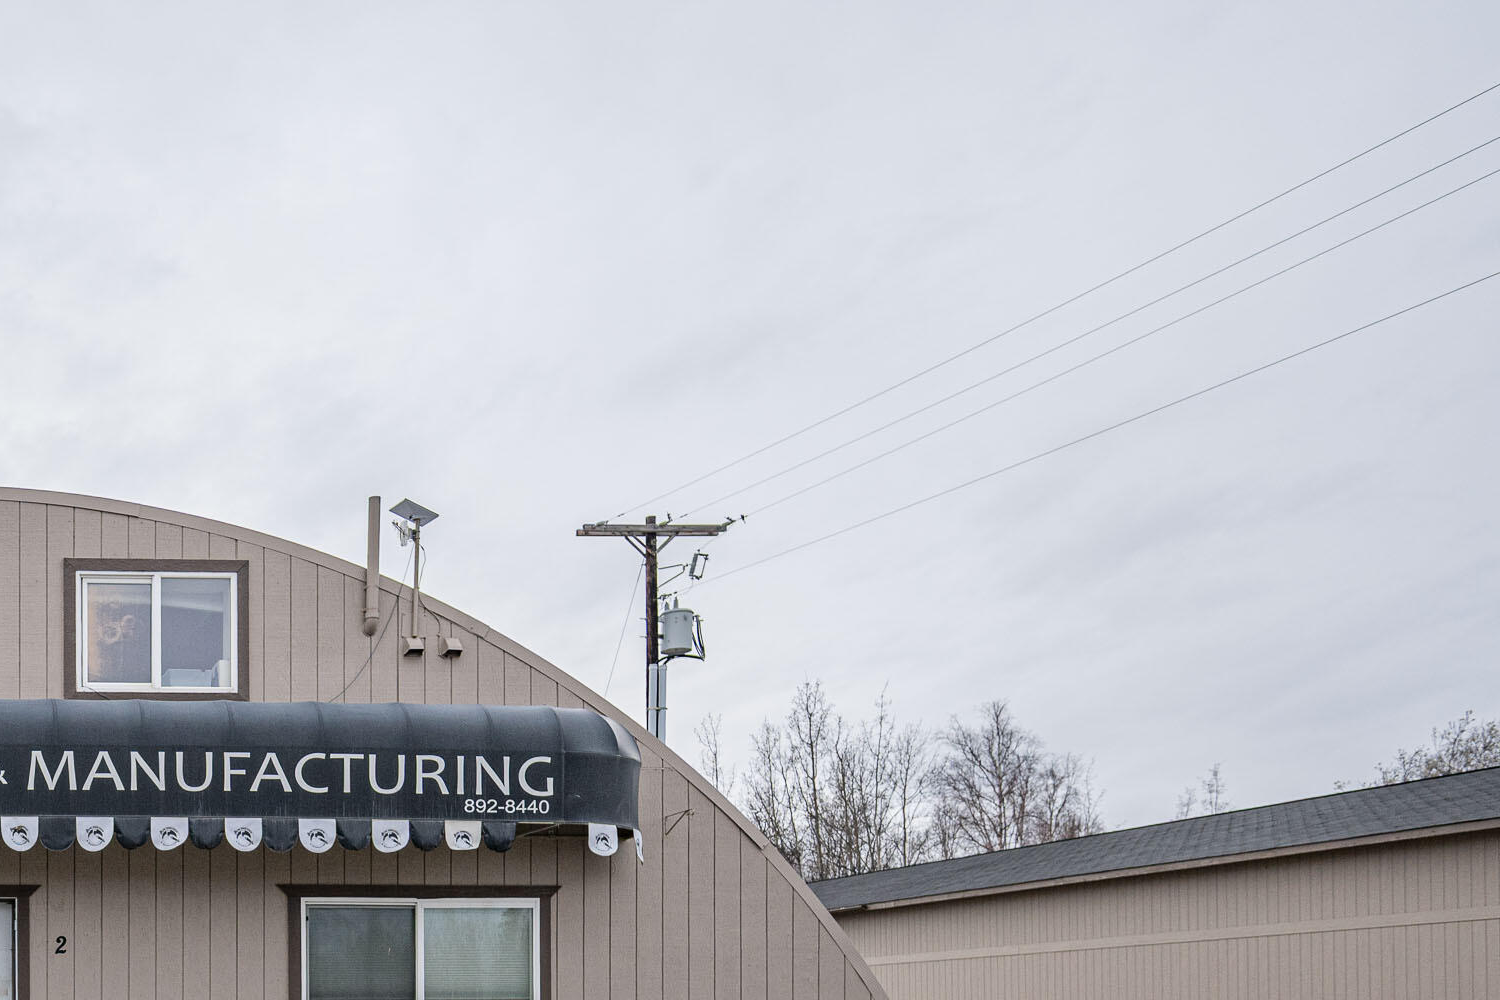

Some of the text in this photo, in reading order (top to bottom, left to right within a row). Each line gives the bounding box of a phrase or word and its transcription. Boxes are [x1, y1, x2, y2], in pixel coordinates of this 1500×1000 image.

[27, 750, 555, 797] MANUFACTURING
[464, 798, 550, 814] 892-8440
[55, 935, 67, 955] 2
